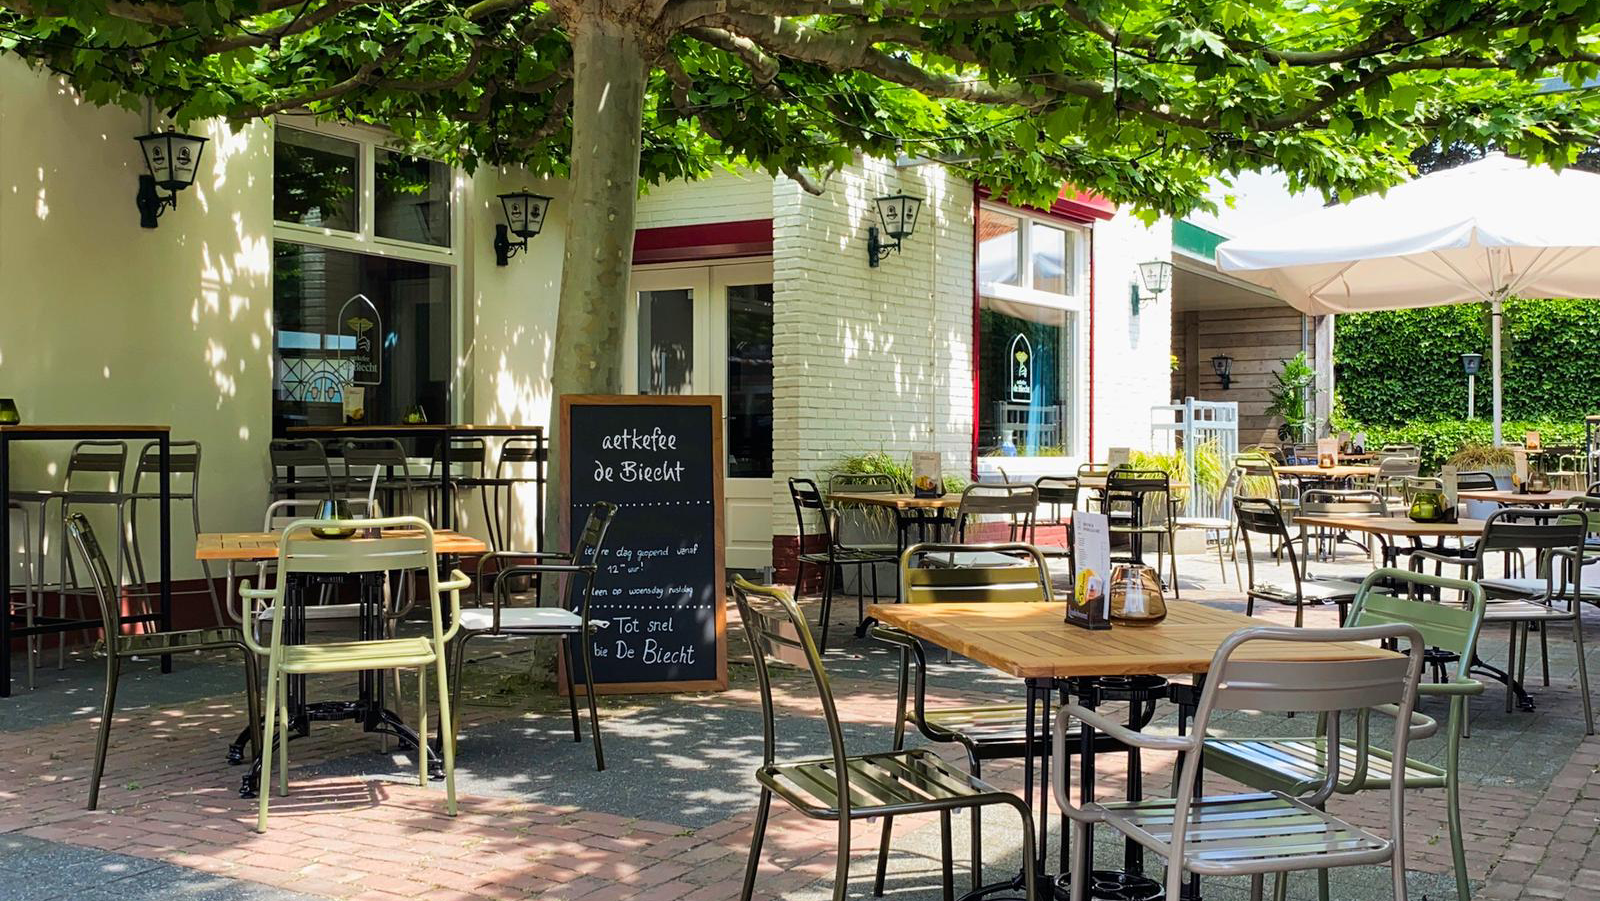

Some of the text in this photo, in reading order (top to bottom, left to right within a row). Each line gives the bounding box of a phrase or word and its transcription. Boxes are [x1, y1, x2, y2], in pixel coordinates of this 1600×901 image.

[602, 427, 676, 451] aetkefee
[594, 460, 685, 482] de Biecht
[584, 545, 609, 556] iere
[616, 546, 632, 561] dag
[676, 543, 698, 555] vanaf
[612, 588, 622, 596] op
[628, 586, 663, 599] woensdag
[668, 585, 693, 599] rustdag
[613, 617, 673, 634] Tot snel
[594, 638, 694, 665] bie De Biecht
